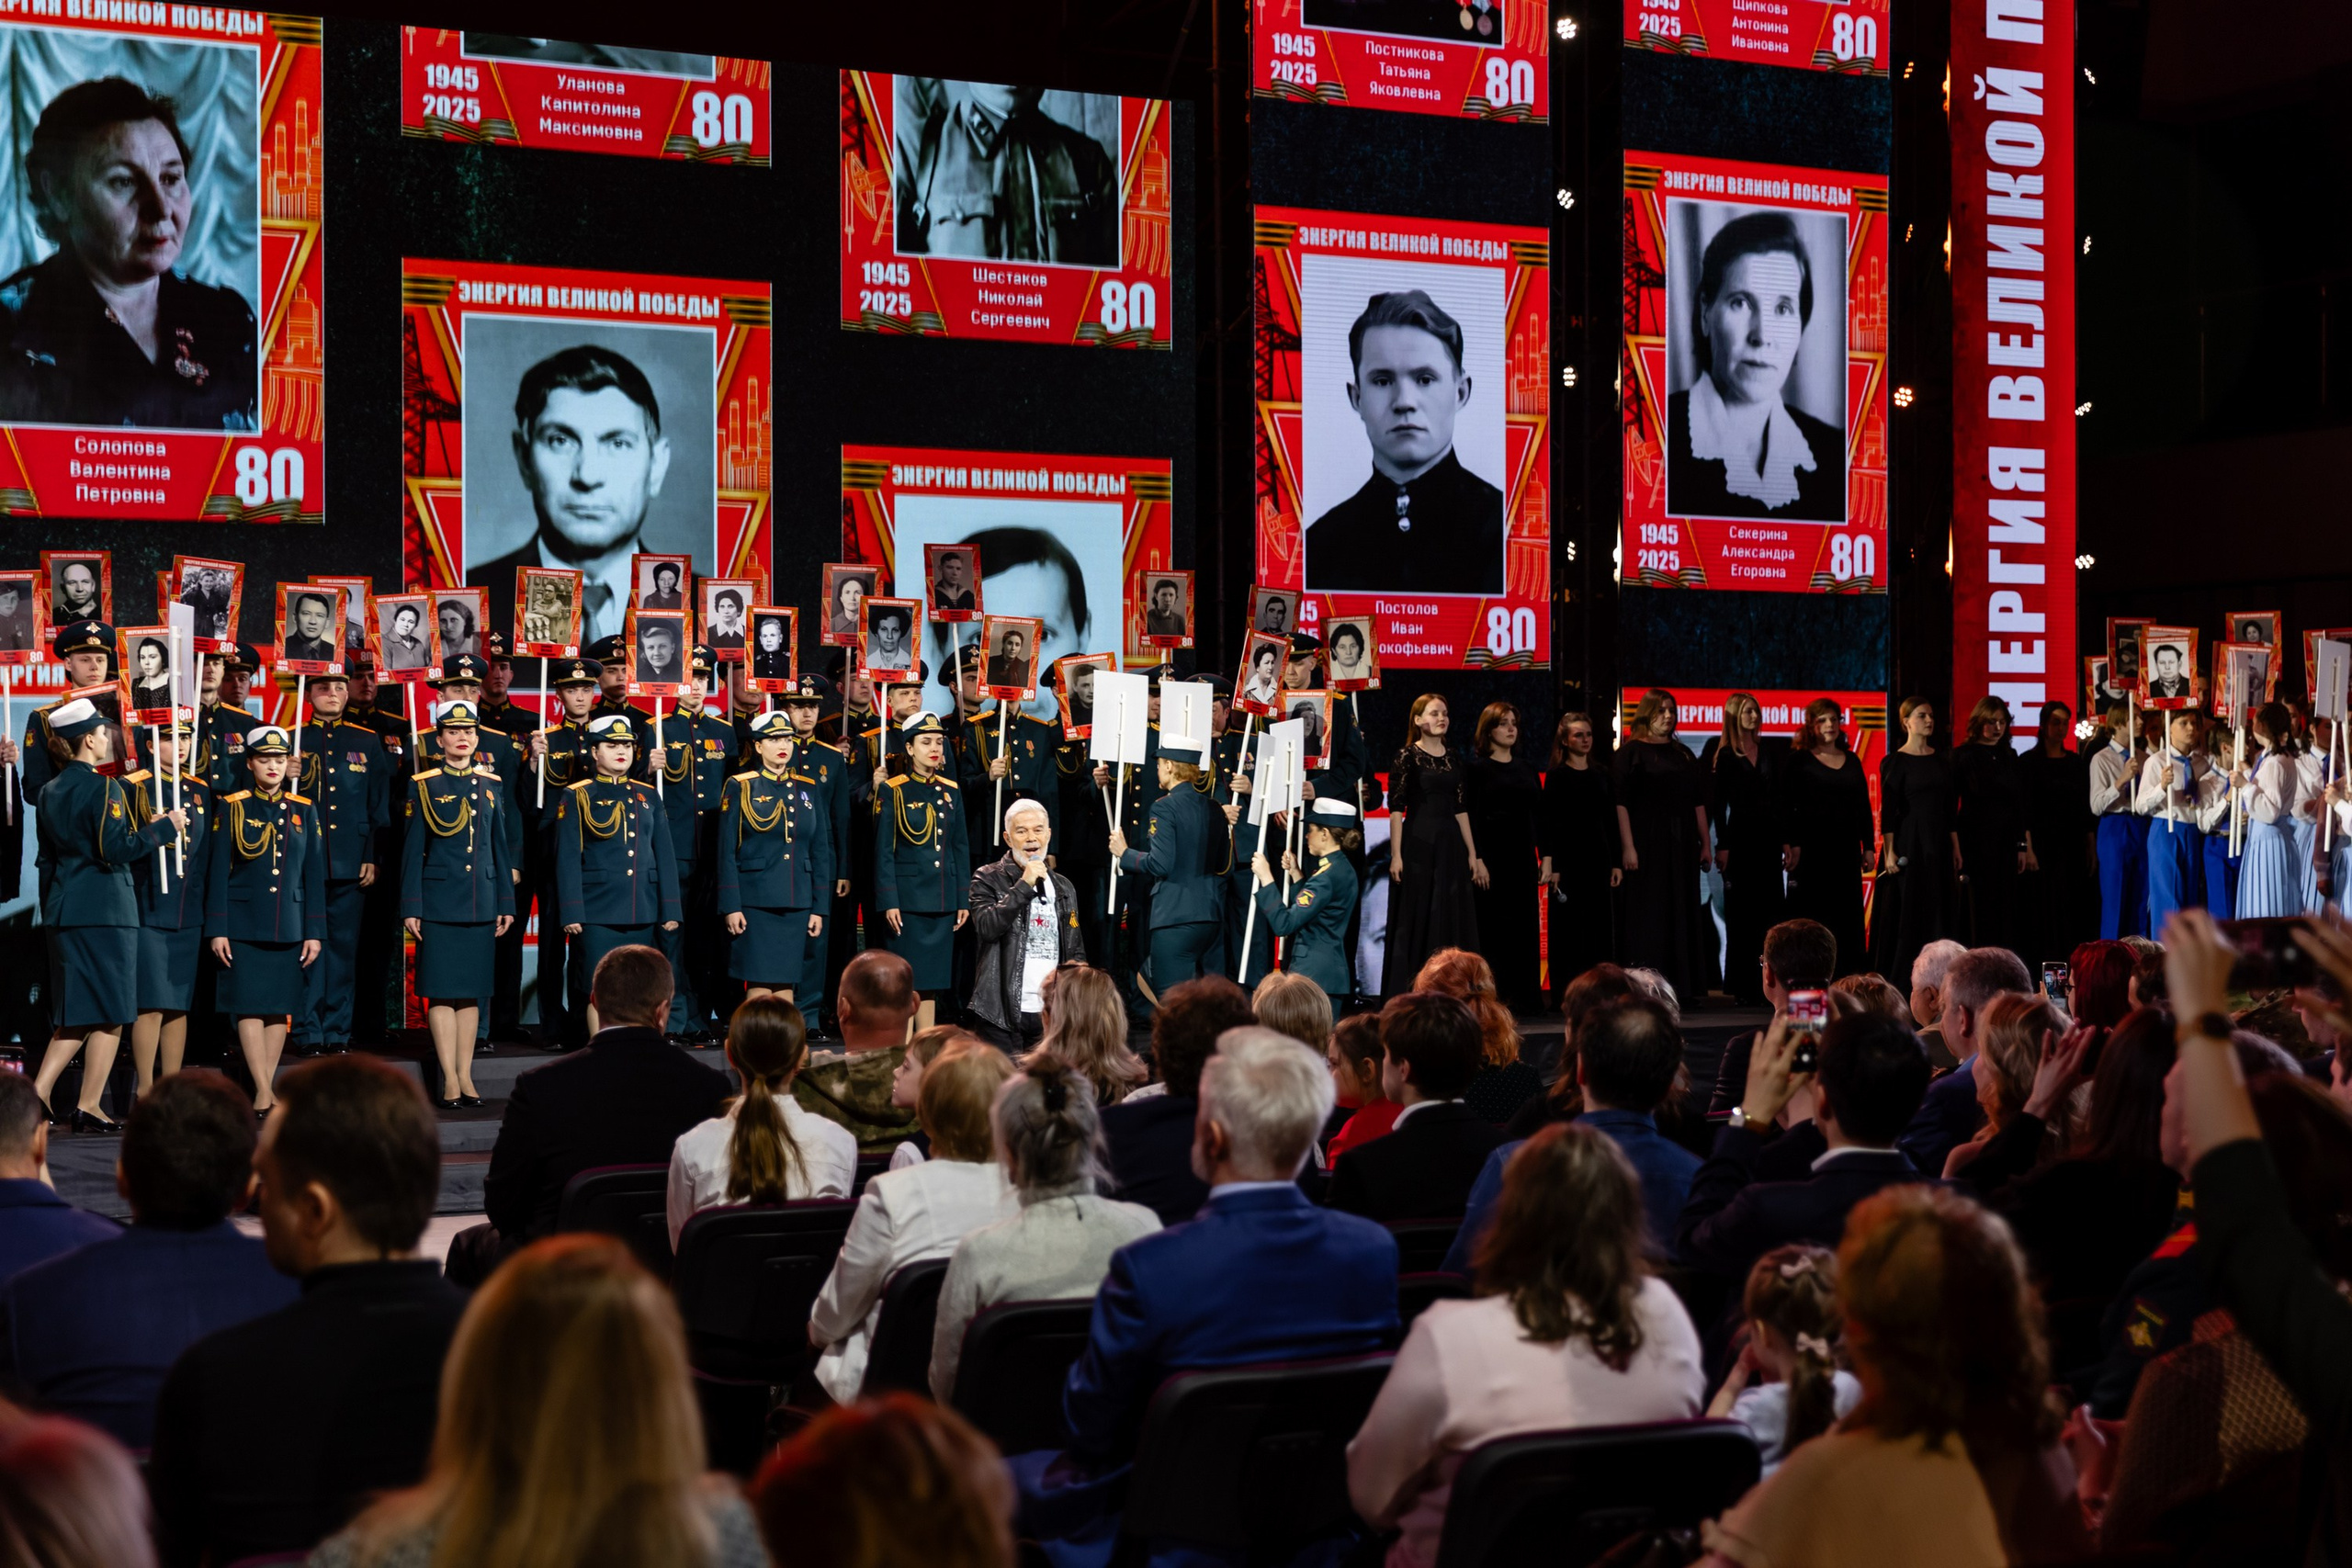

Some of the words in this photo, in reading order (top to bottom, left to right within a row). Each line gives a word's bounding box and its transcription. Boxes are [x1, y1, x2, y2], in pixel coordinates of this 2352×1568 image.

[67, 0, 166, 27] ВЕЛИКОЙ
[171, 5, 264, 37] ПОБЕДЫ
[1733, 0, 1788, 16] Щипкова
[1639, 12, 1681, 37] 2025
[1732, 16, 1789, 34] Антонина
[1832, 12, 1877, 61] 80
[1272, 32, 1316, 58] 1945
[1365, 39, 1444, 62] Постникова
[1732, 34, 1789, 53] Ивановна
[424, 63, 479, 92] 1945
[1270, 60, 1317, 85] 2025
[1379, 62, 1430, 82] Татьяна
[1485, 56, 1534, 108] 80
[557, 73, 626, 96] Уланова
[1369, 81, 1442, 102] Яковлевна
[423, 94, 481, 123] 2025
[541, 95, 641, 119] Капитолина
[692, 90, 753, 148] 80
[539, 117, 643, 141] Максимовна
[1664, 170, 1724, 194] ЭНЕРГИЯ
[1727, 175, 1791, 200] ВЕЛИКОЙ
[1792, 183, 1851, 207] ПОБЕДЫ
[1299, 226, 1366, 250] ЭНЕРГИЯ
[1369, 232, 1440, 255] ВЕЛИКОЙ
[1442, 237, 1508, 263] ПОБЕДЫ
[1973, 66, 2045, 422] ВЕЛИКОЙ
[862, 261, 910, 287] 1945
[973, 266, 1048, 288] Шестаков
[458, 280, 543, 308] ЭНЕРГИЯ
[547, 286, 634, 314] ВЕЛИКОЙ
[639, 292, 720, 320] ПОБЕДЫ
[860, 289, 912, 317] 2025
[978, 288, 1043, 309] Николай
[1101, 279, 1156, 334] 80
[970, 309, 1050, 329] Сергеевич
[74, 435, 166, 457] Солопова
[70, 459, 171, 480] Валентина
[235, 446, 304, 507] 80
[892, 464, 967, 490] ЭНЕРГИЯ
[971, 467, 1049, 492] ВЕЛИКОЙ
[1053, 472, 1126, 497] ПОБЕДЫ
[75, 483, 165, 505] Петровна
[1640, 523, 1679, 545] 1945
[1729, 525, 1788, 541] Секерина
[1638, 548, 1680, 571] 2025
[1722, 544, 1795, 561] Александра
[1831, 533, 1875, 581] 80
[1731, 563, 1787, 580] Егоровна
[1375, 600, 1439, 615] Постолов
[1988, 446, 2045, 756] НЕРГИЯ
[1392, 620, 1423, 635] Иван
[1487, 606, 1536, 657] 80
[1379, 641, 1453, 657] окофьевич
[1677, 705, 1724, 724] ЕРГИЯ
